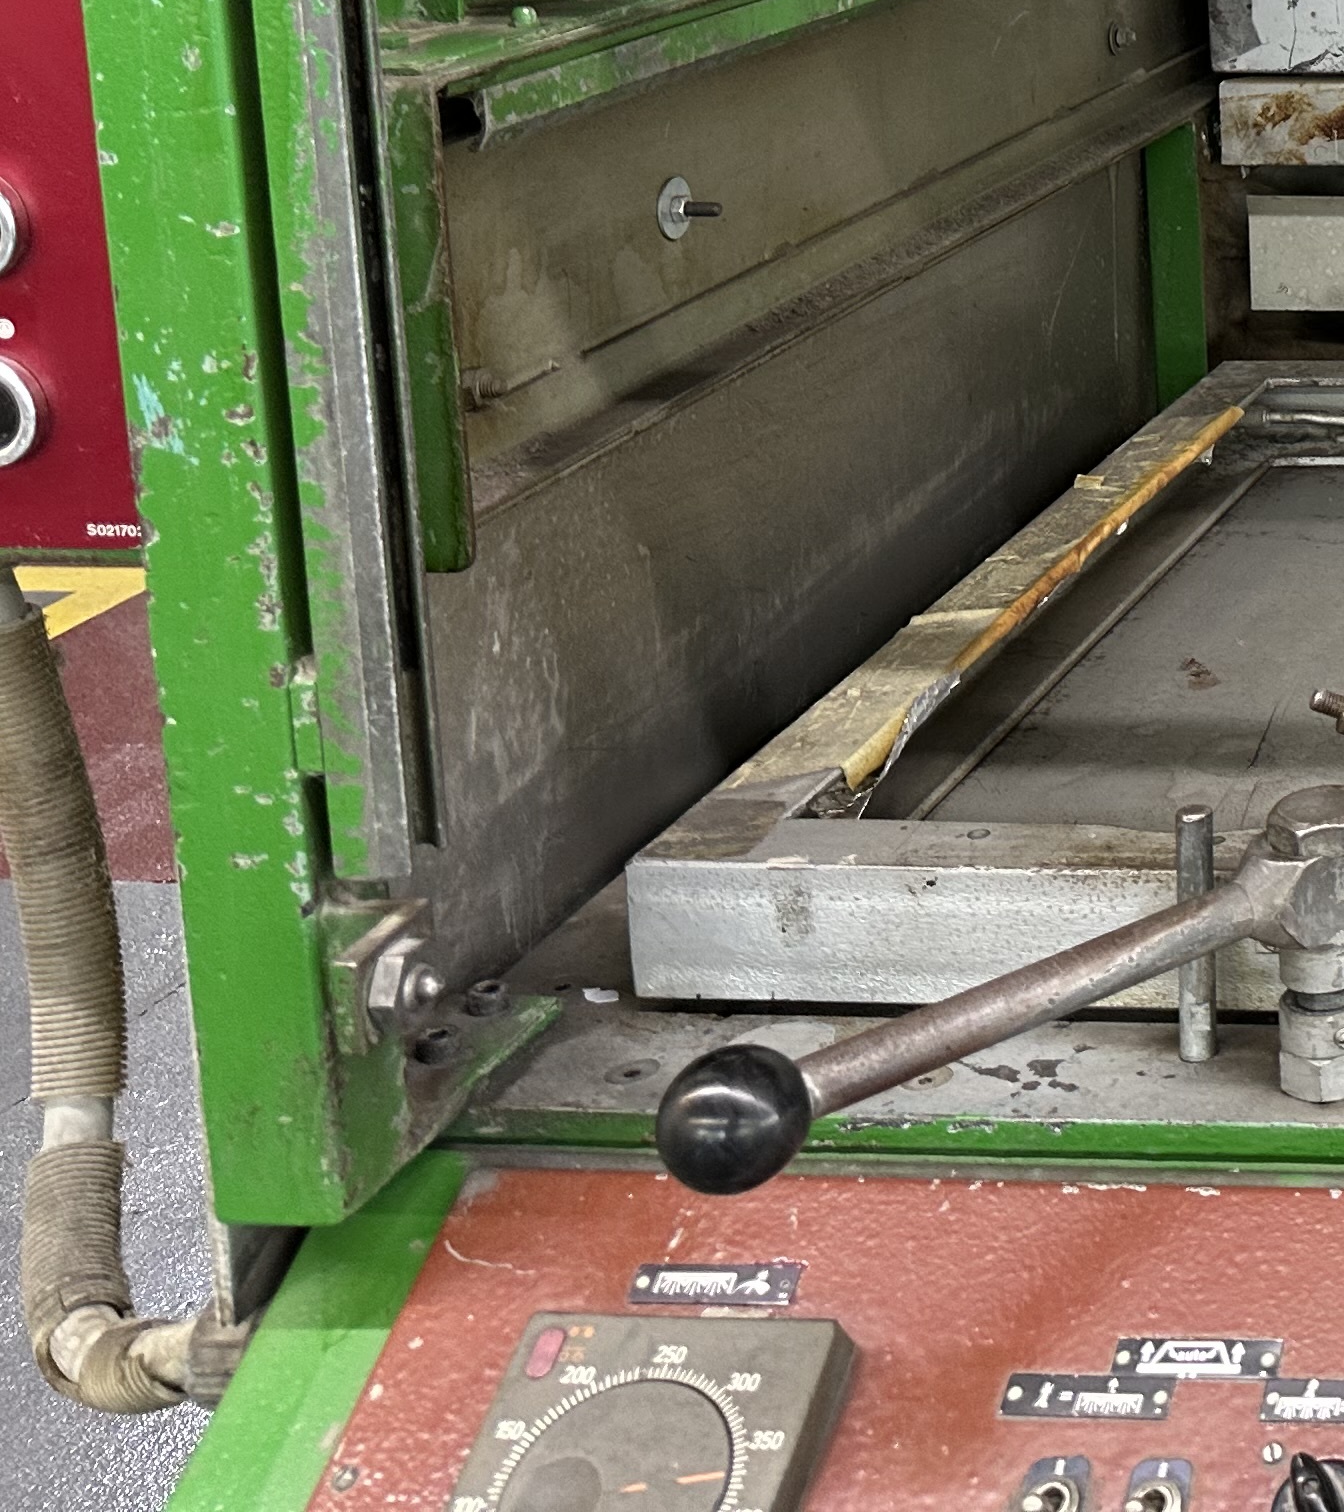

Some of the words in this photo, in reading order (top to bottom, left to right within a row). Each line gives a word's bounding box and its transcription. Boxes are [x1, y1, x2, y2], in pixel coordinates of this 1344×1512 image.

[653, 1345, 688, 1364] 250
[559, 1365, 598, 1385] 200
[728, 1372, 762, 1392] 300
[495, 1420, 526, 1440] 150
[749, 1430, 785, 1450] 350
